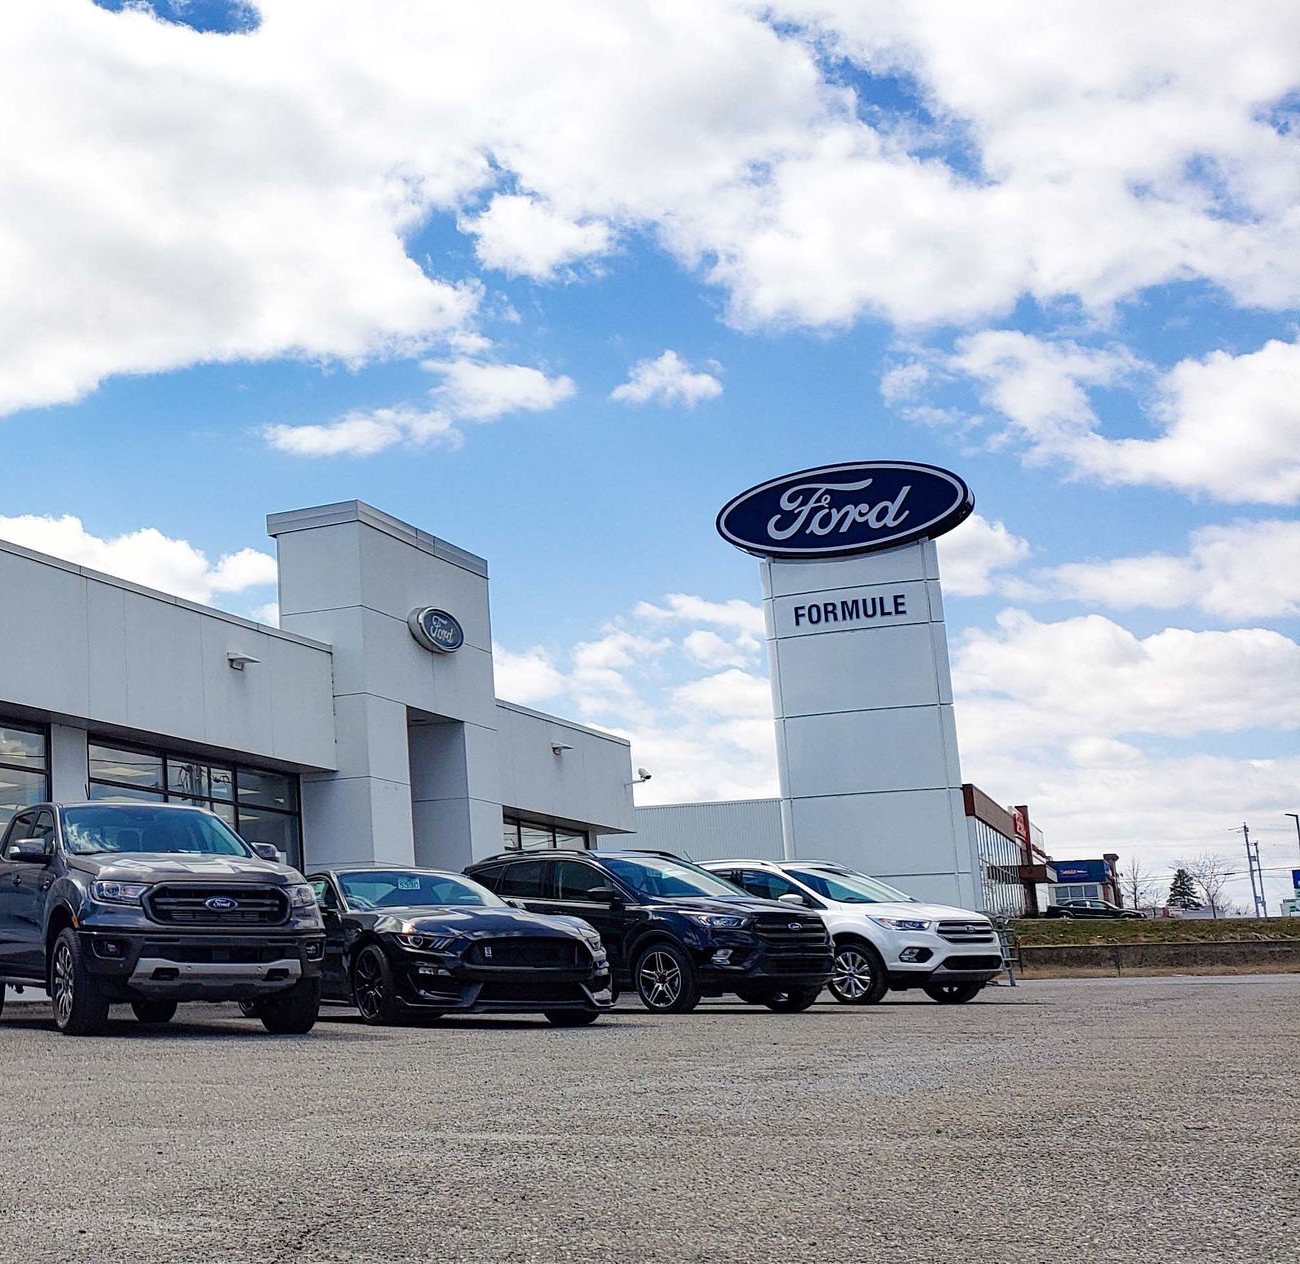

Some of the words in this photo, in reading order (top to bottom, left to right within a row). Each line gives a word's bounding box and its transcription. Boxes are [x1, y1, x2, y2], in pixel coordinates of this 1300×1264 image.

[767, 478, 911, 540] Ford
[794, 594, 907, 626] FORMULE
[430, 615, 453, 643] Ford
